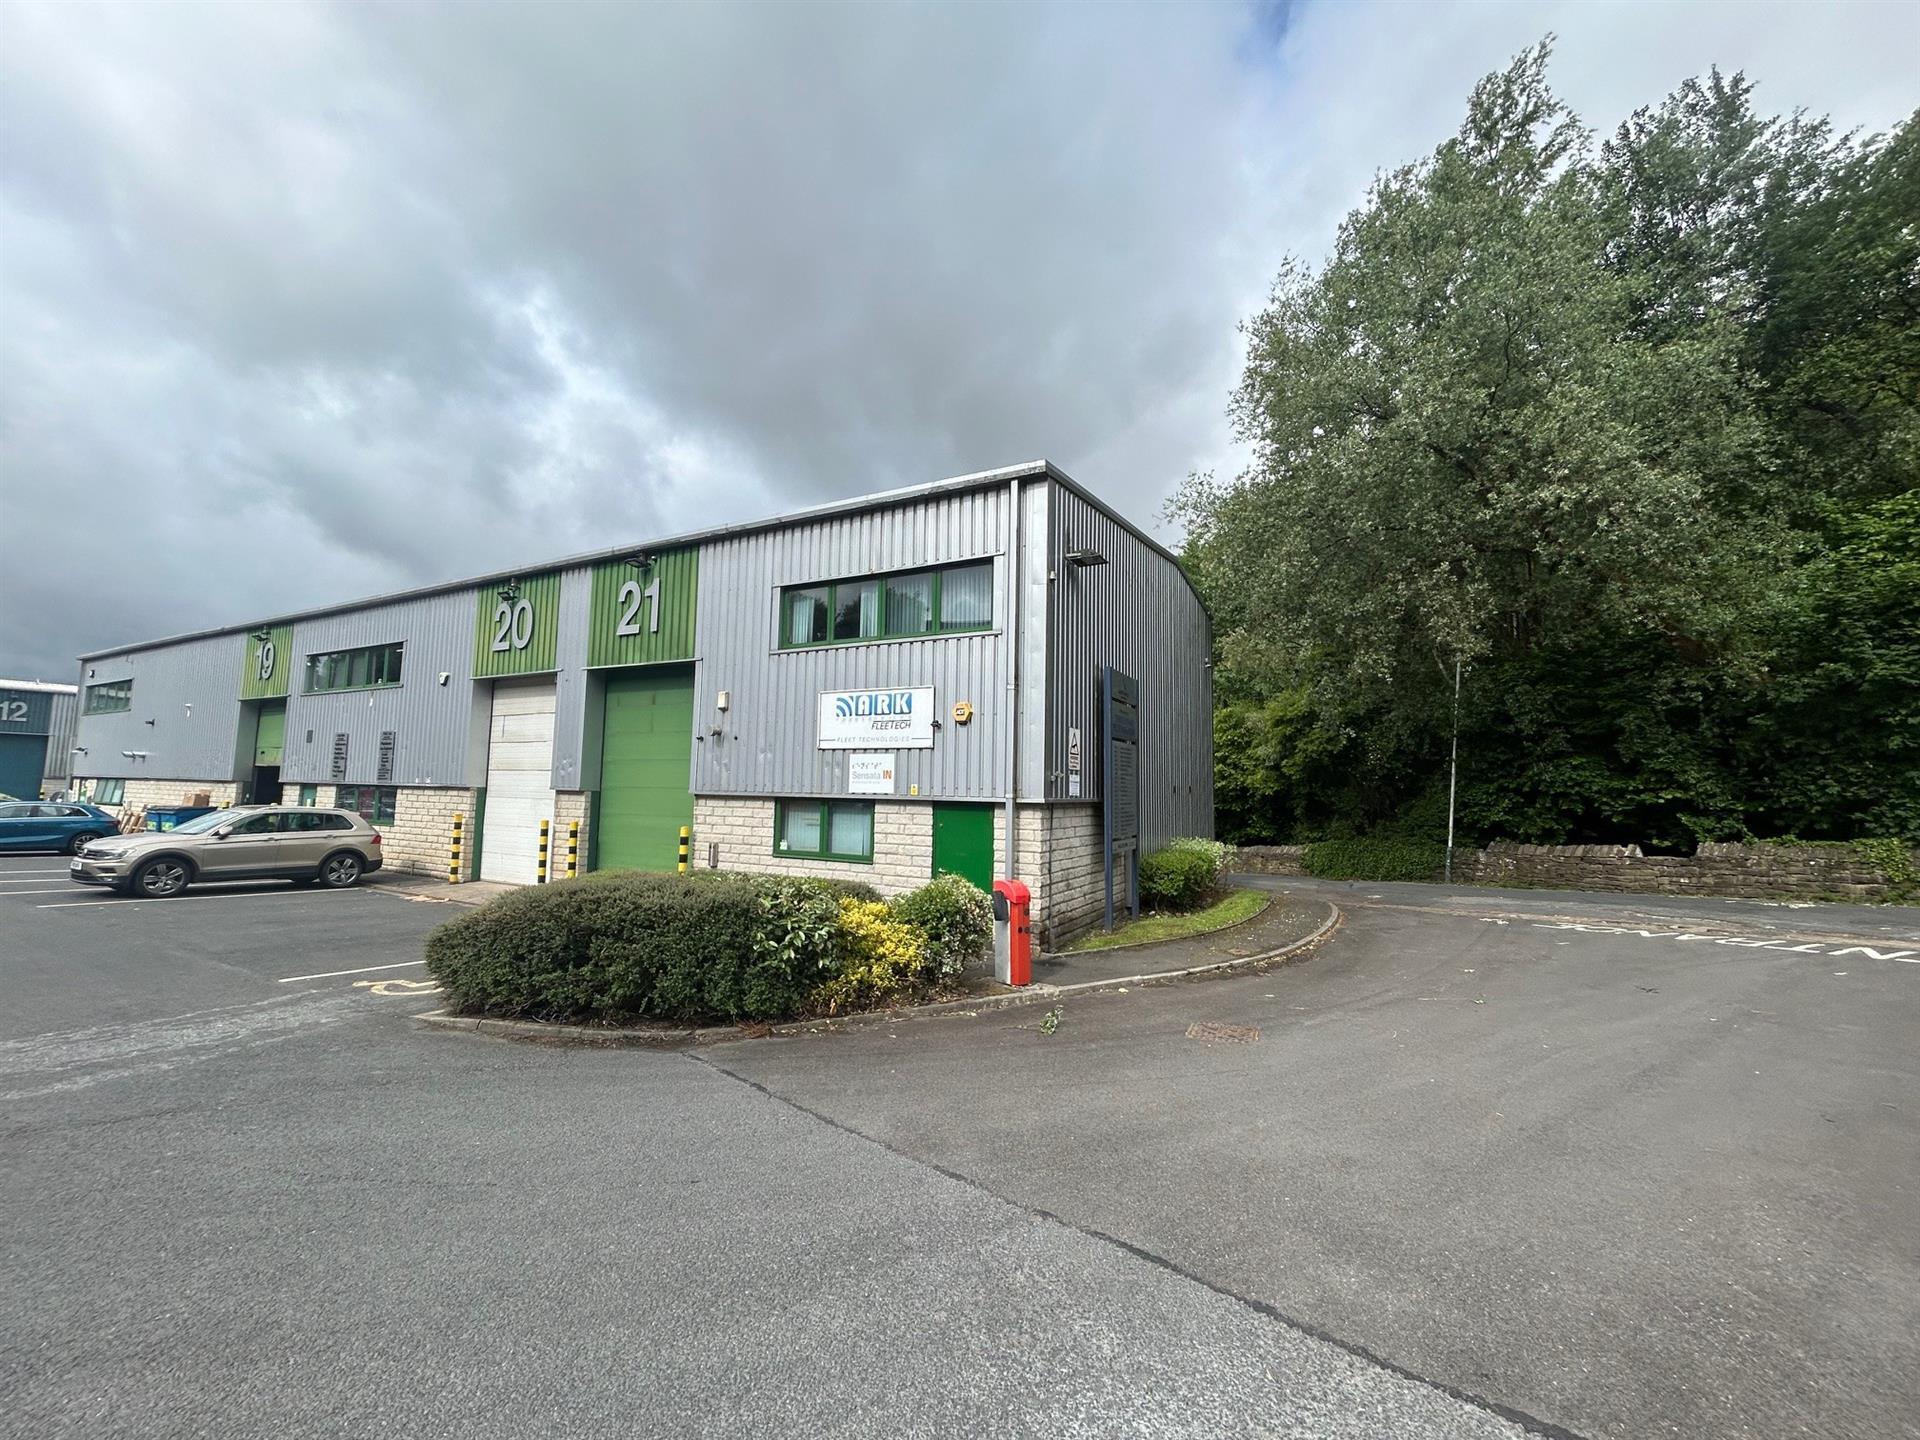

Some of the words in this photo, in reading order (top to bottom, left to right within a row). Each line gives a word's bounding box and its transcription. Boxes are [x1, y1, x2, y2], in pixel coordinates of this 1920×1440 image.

[492, 599, 533, 651] 20
[616, 577, 661, 636] 21
[256, 642, 275, 680] 19
[0, 701, 28, 722] 12
[855, 692, 912, 716] ARK
